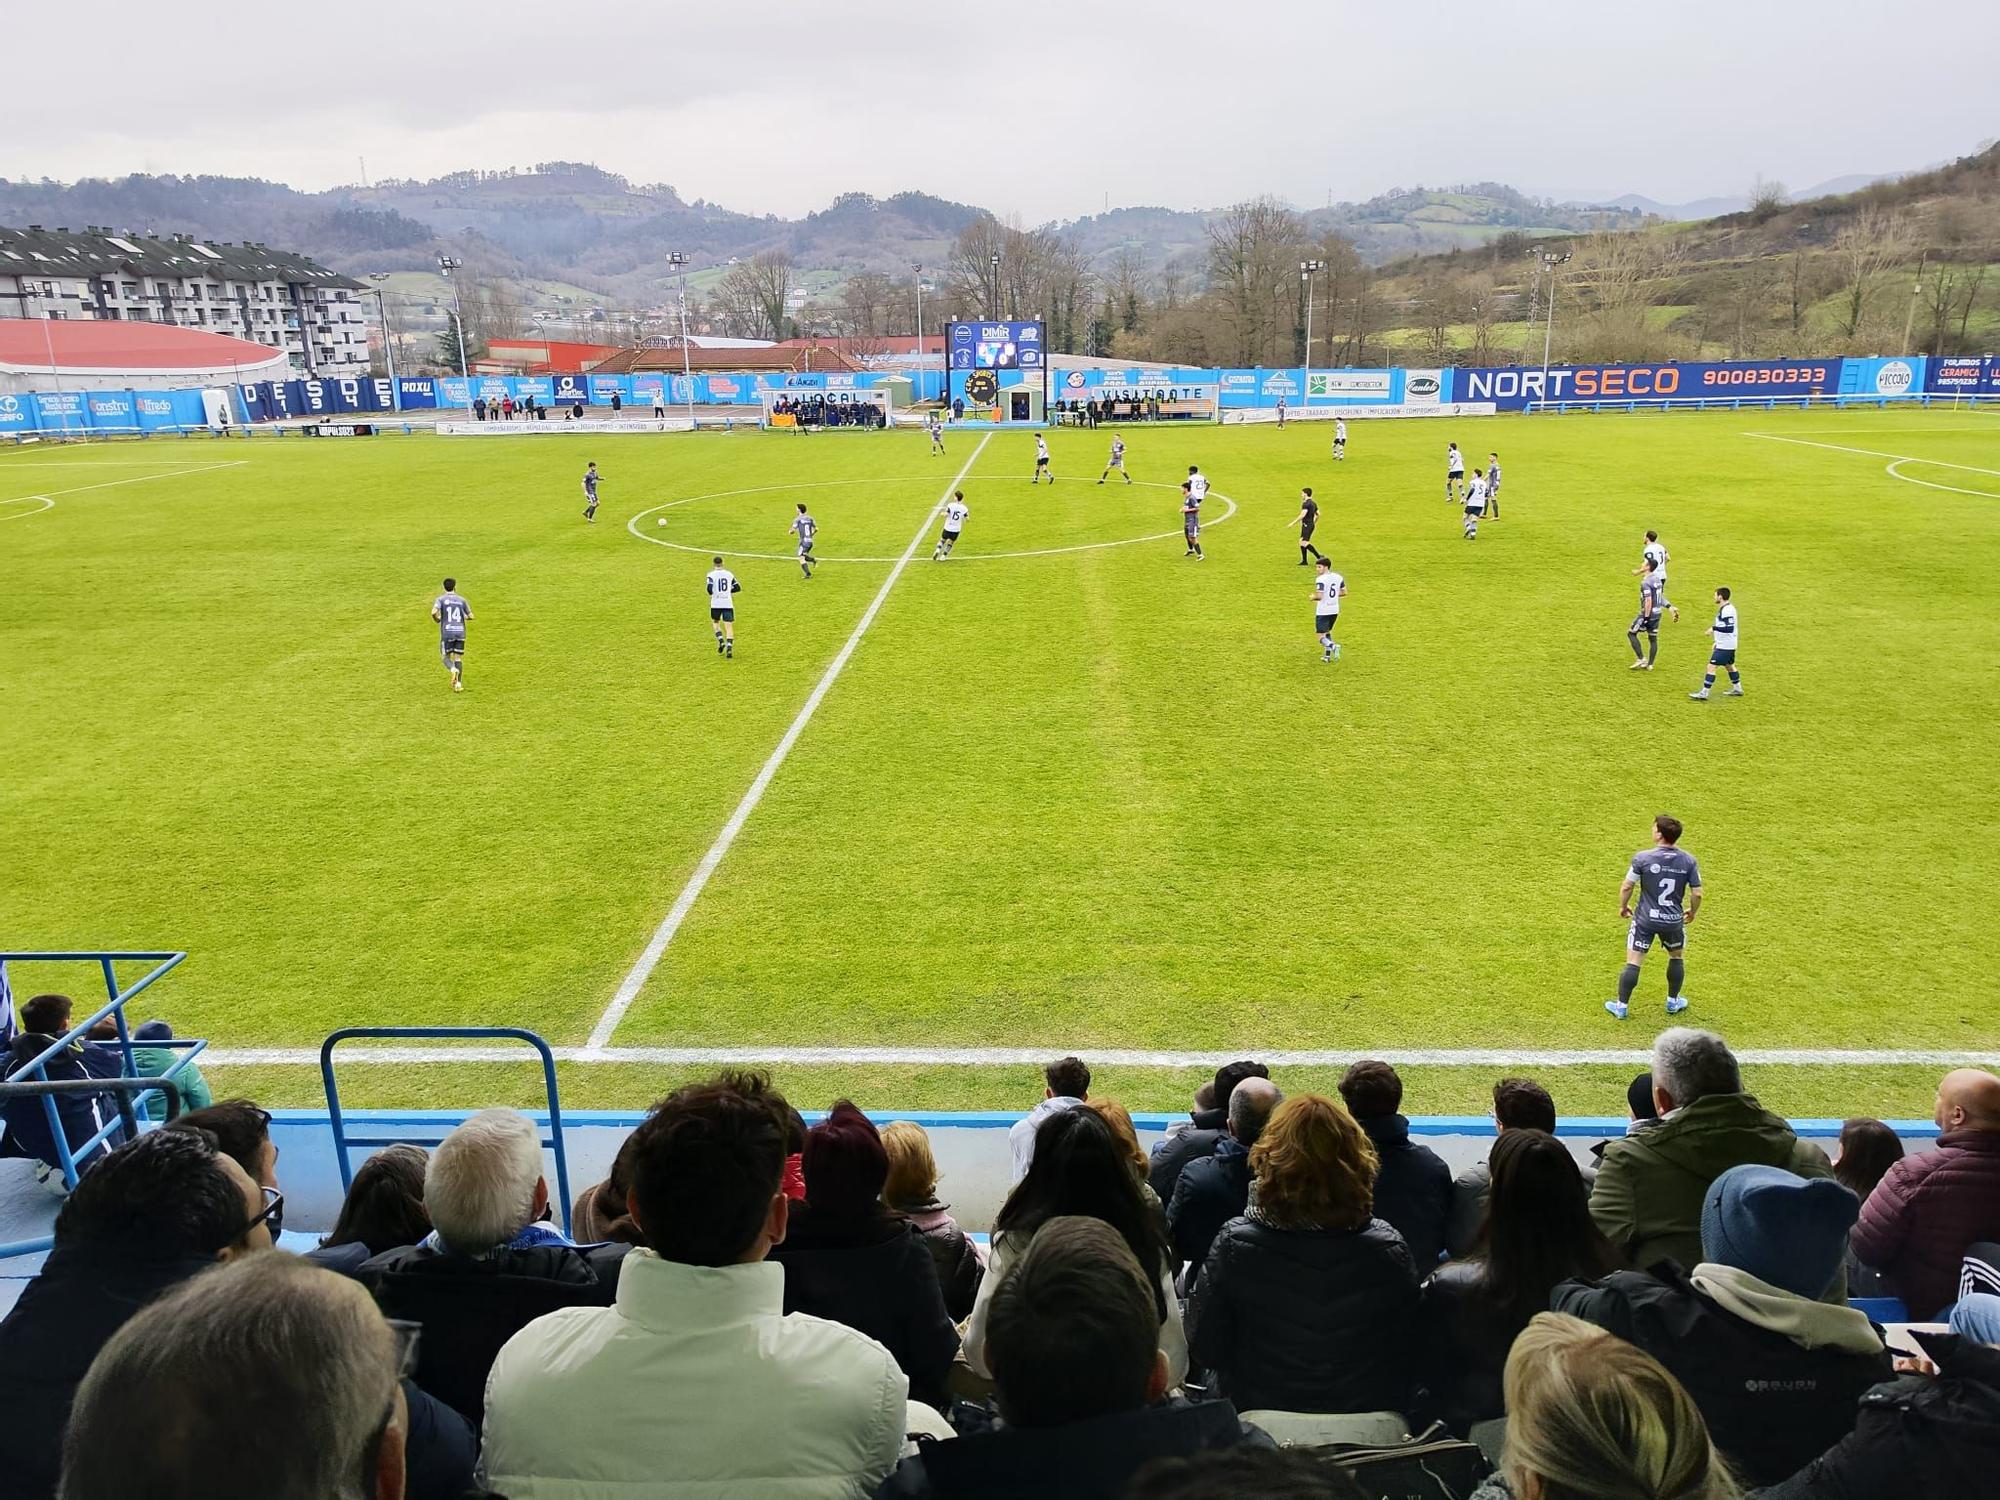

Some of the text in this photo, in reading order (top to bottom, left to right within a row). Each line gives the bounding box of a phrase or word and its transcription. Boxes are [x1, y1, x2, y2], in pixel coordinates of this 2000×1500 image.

[1703, 368, 1826, 385] 900830333
[1879, 373, 1910, 386] PICCOLO
[401, 382, 432, 393] ROXU
[802, 393, 860, 404] LOCAL
[951, 511, 960, 521] 15
[1659, 551, 1664, 565] 3
[718, 578, 728, 593] 18
[1328, 583, 1336, 598] 6
[446, 606, 461, 622] 14
[1658, 878, 1676, 906] 2
